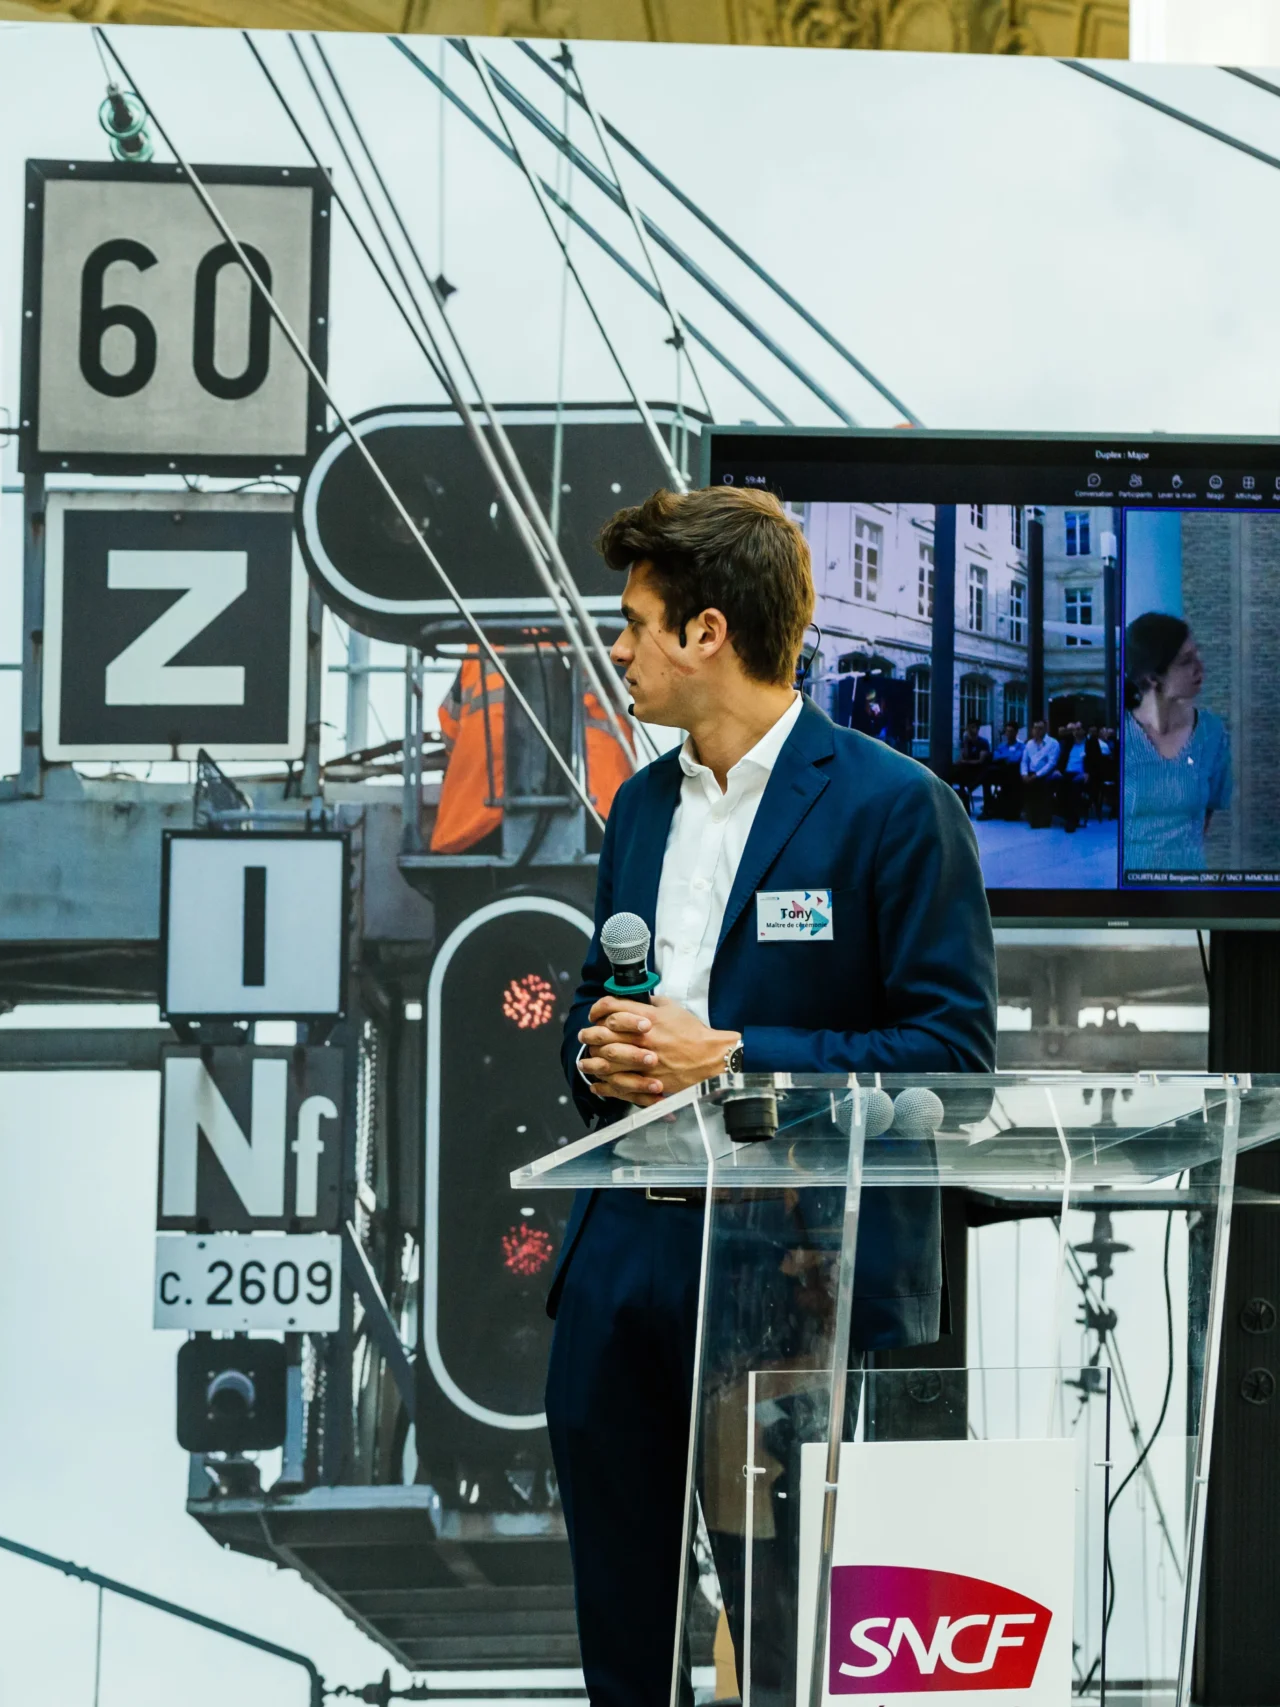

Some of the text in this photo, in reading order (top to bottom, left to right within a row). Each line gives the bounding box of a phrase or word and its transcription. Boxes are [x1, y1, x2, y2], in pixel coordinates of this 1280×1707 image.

[79, 238, 272, 400] 60
[745, 475, 766, 485] 59:44
[1127, 451, 1150, 461] Major
[104, 549, 248, 706] Z
[241, 866, 267, 987] I
[780, 908, 812, 922] Tony
[162, 1056, 339, 1218] Nf
[838, 1613, 1037, 1678] SNCF
